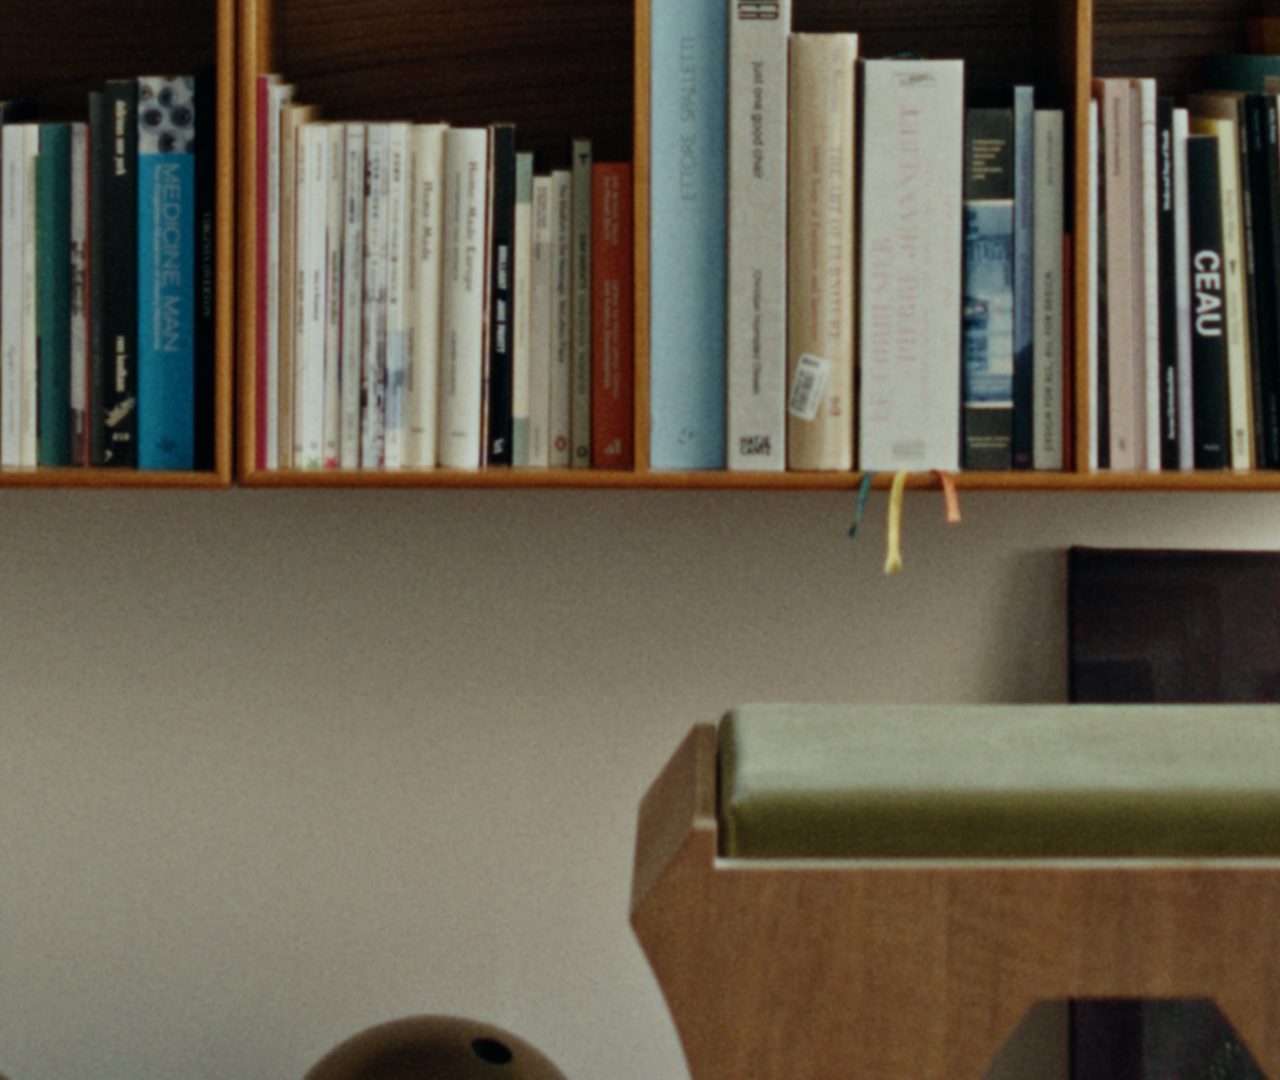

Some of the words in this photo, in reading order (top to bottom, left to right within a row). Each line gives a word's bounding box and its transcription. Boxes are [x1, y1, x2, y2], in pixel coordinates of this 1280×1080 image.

[680, 36, 697, 123] SPALLETTI
[752, 86, 763, 111] one
[750, 113, 765, 146] good
[680, 131, 697, 201] ETTORE
[752, 148, 765, 180] chair
[828, 145, 843, 179] THE
[466, 160, 479, 242] Home-Made
[828, 183, 843, 216] ART
[162, 162, 181, 288] MEDICINE
[422, 181, 433, 262] Home-Made
[828, 219, 843, 238] OF
[463, 245, 477, 294] Europe
[828, 243, 844, 340] FURNITURE
[1040, 271, 1053, 311] DESIGN
[1194, 250, 1221, 337] CEAU
[162, 294, 182, 353] MAN
[1040, 315, 1053, 336] FOR
[1039, 387, 1053, 409] FOR
[1039, 411, 1053, 453] DESIGN
